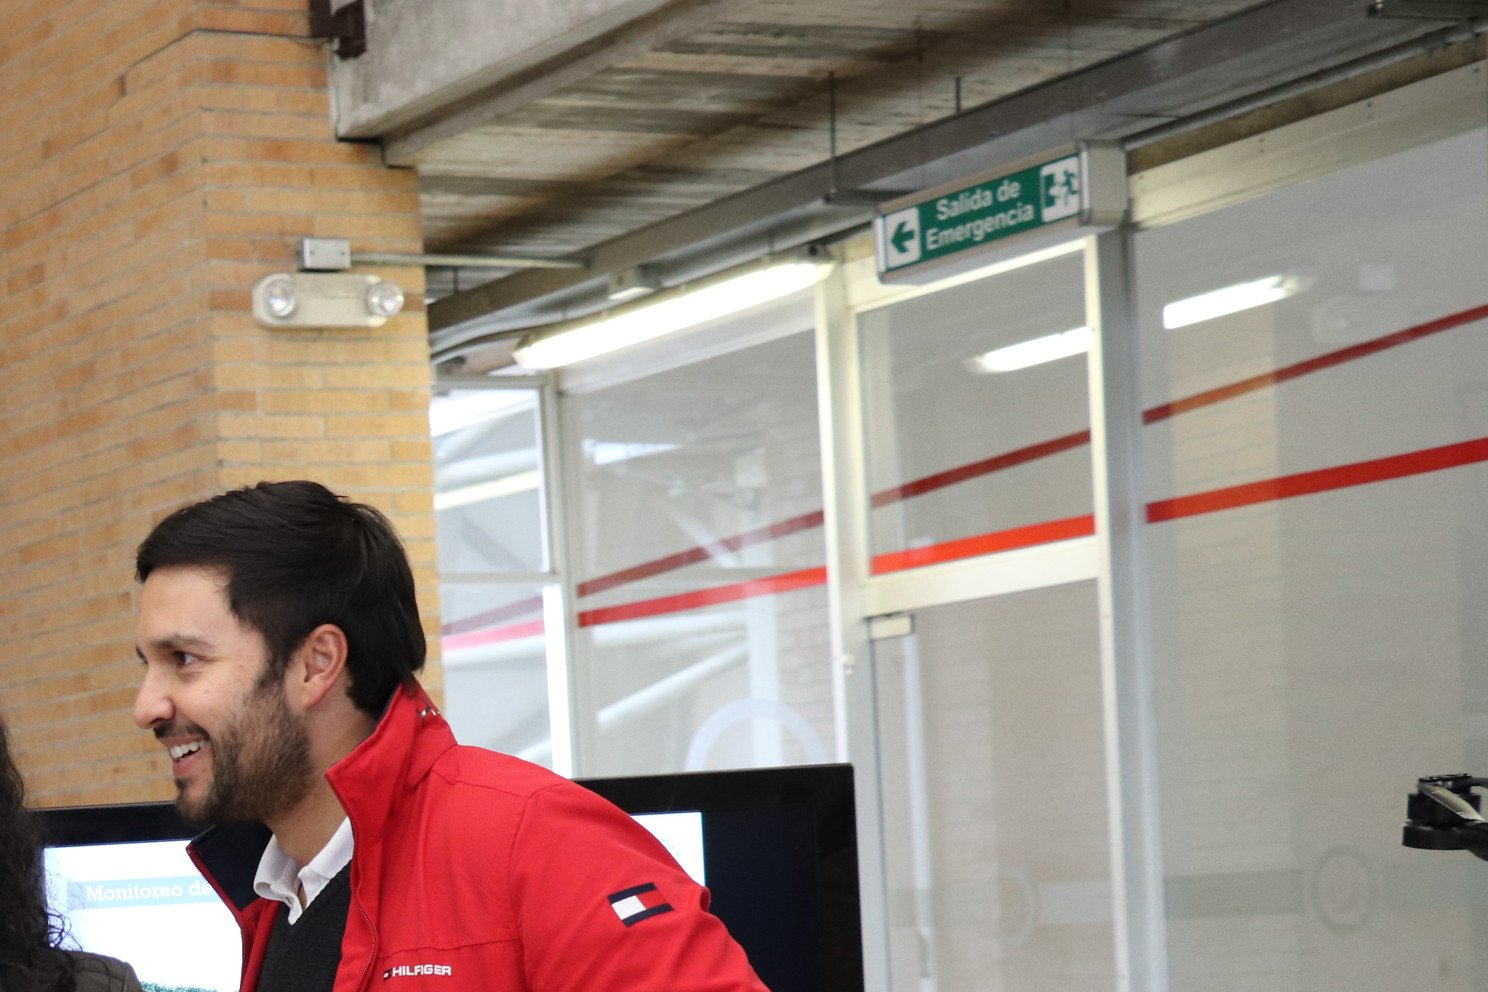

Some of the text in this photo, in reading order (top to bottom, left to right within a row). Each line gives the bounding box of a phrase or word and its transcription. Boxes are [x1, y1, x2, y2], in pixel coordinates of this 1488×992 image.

[935, 179, 1021, 220] Salida de
[925, 202, 1035, 250] Emergencia
[84, 883, 184, 902] Monitoreo
[391, 964, 452, 977] HILFIGER
